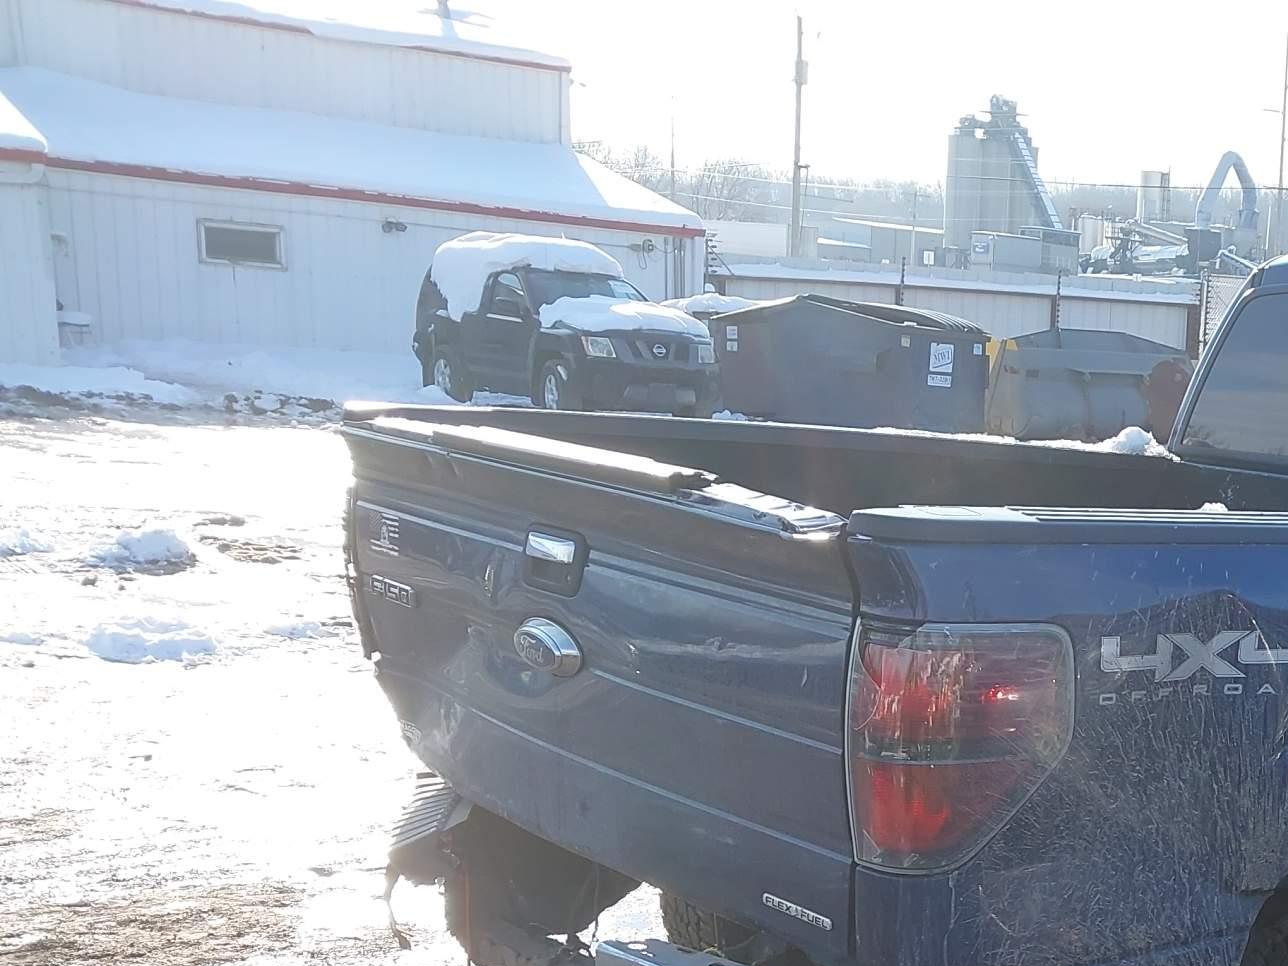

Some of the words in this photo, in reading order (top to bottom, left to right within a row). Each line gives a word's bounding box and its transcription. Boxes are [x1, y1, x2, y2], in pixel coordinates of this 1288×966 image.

[520, 634, 545, 664] Ford
[764, 895, 793, 914] FLEX
[799, 910, 830, 929] FUEL
